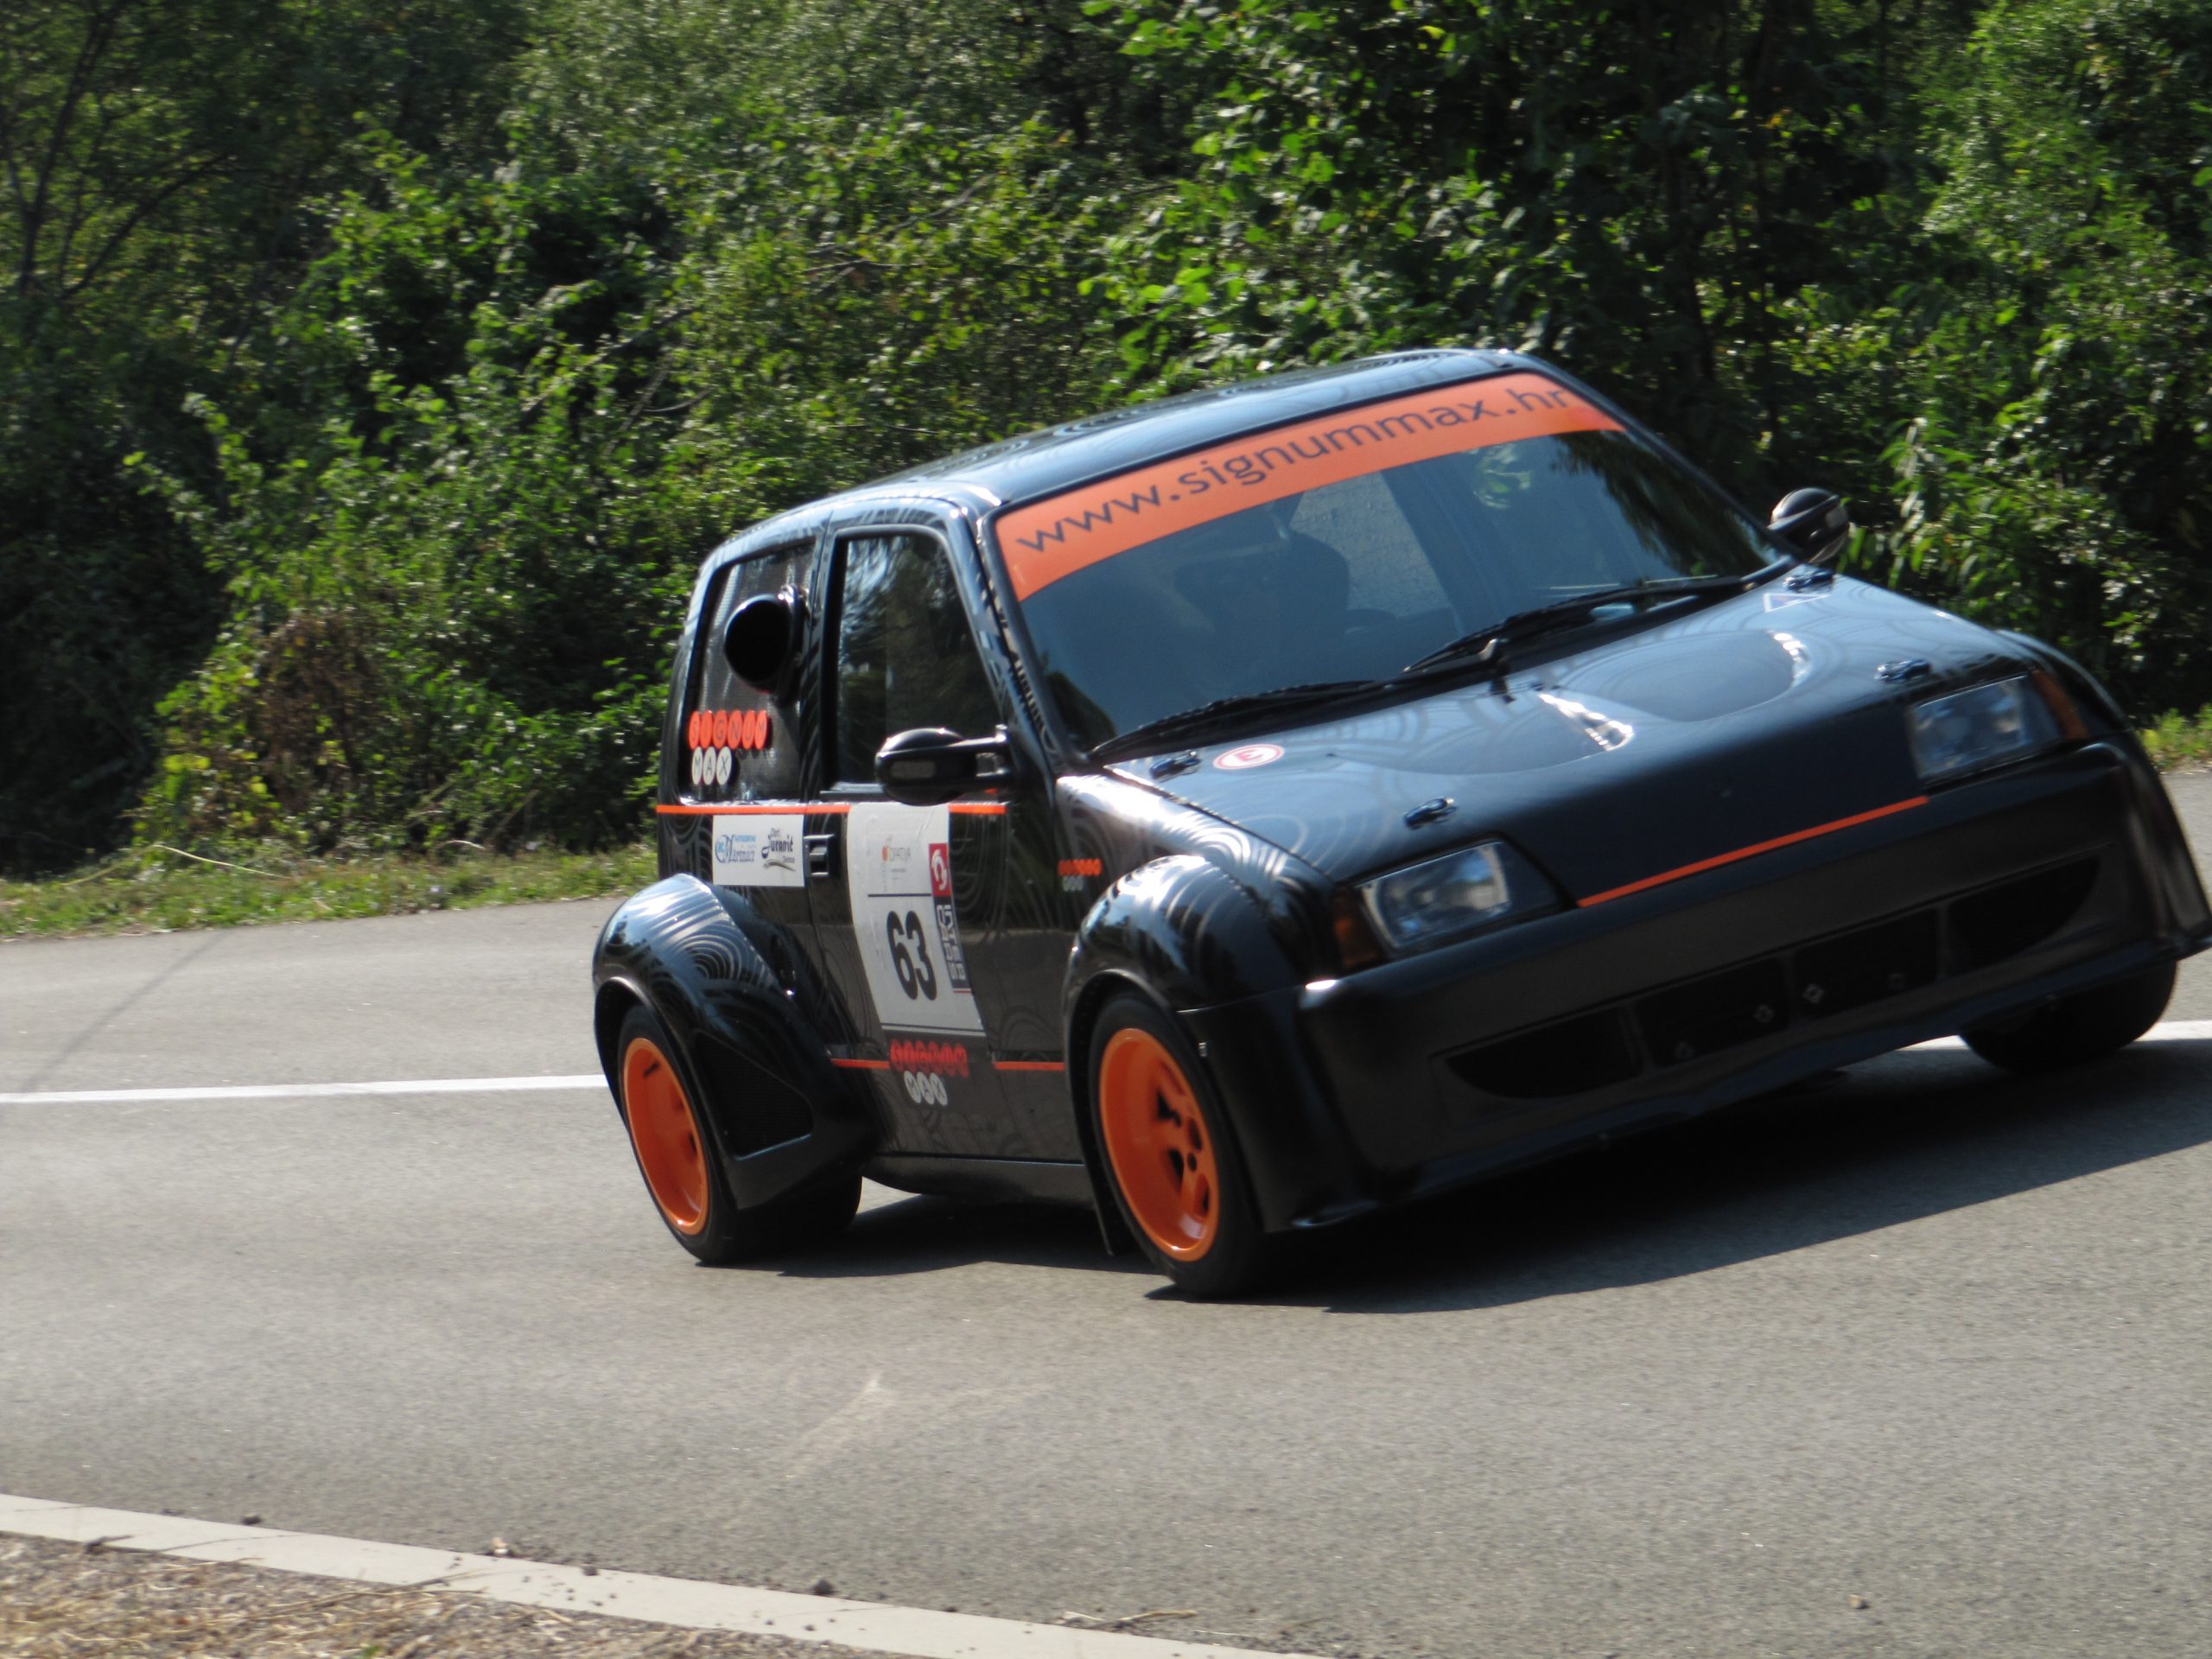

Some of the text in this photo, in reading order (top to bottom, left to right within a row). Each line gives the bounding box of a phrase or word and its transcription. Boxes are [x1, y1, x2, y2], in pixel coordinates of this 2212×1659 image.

[1016, 386, 1569, 553] www.signummax.hr
[690, 714, 766, 746] SIGNUM
[693, 751, 730, 780] MAX
[1235, 749, 1263, 762] E
[887, 911, 937, 1001] 63
[906, 1075, 947, 1103] MAX
